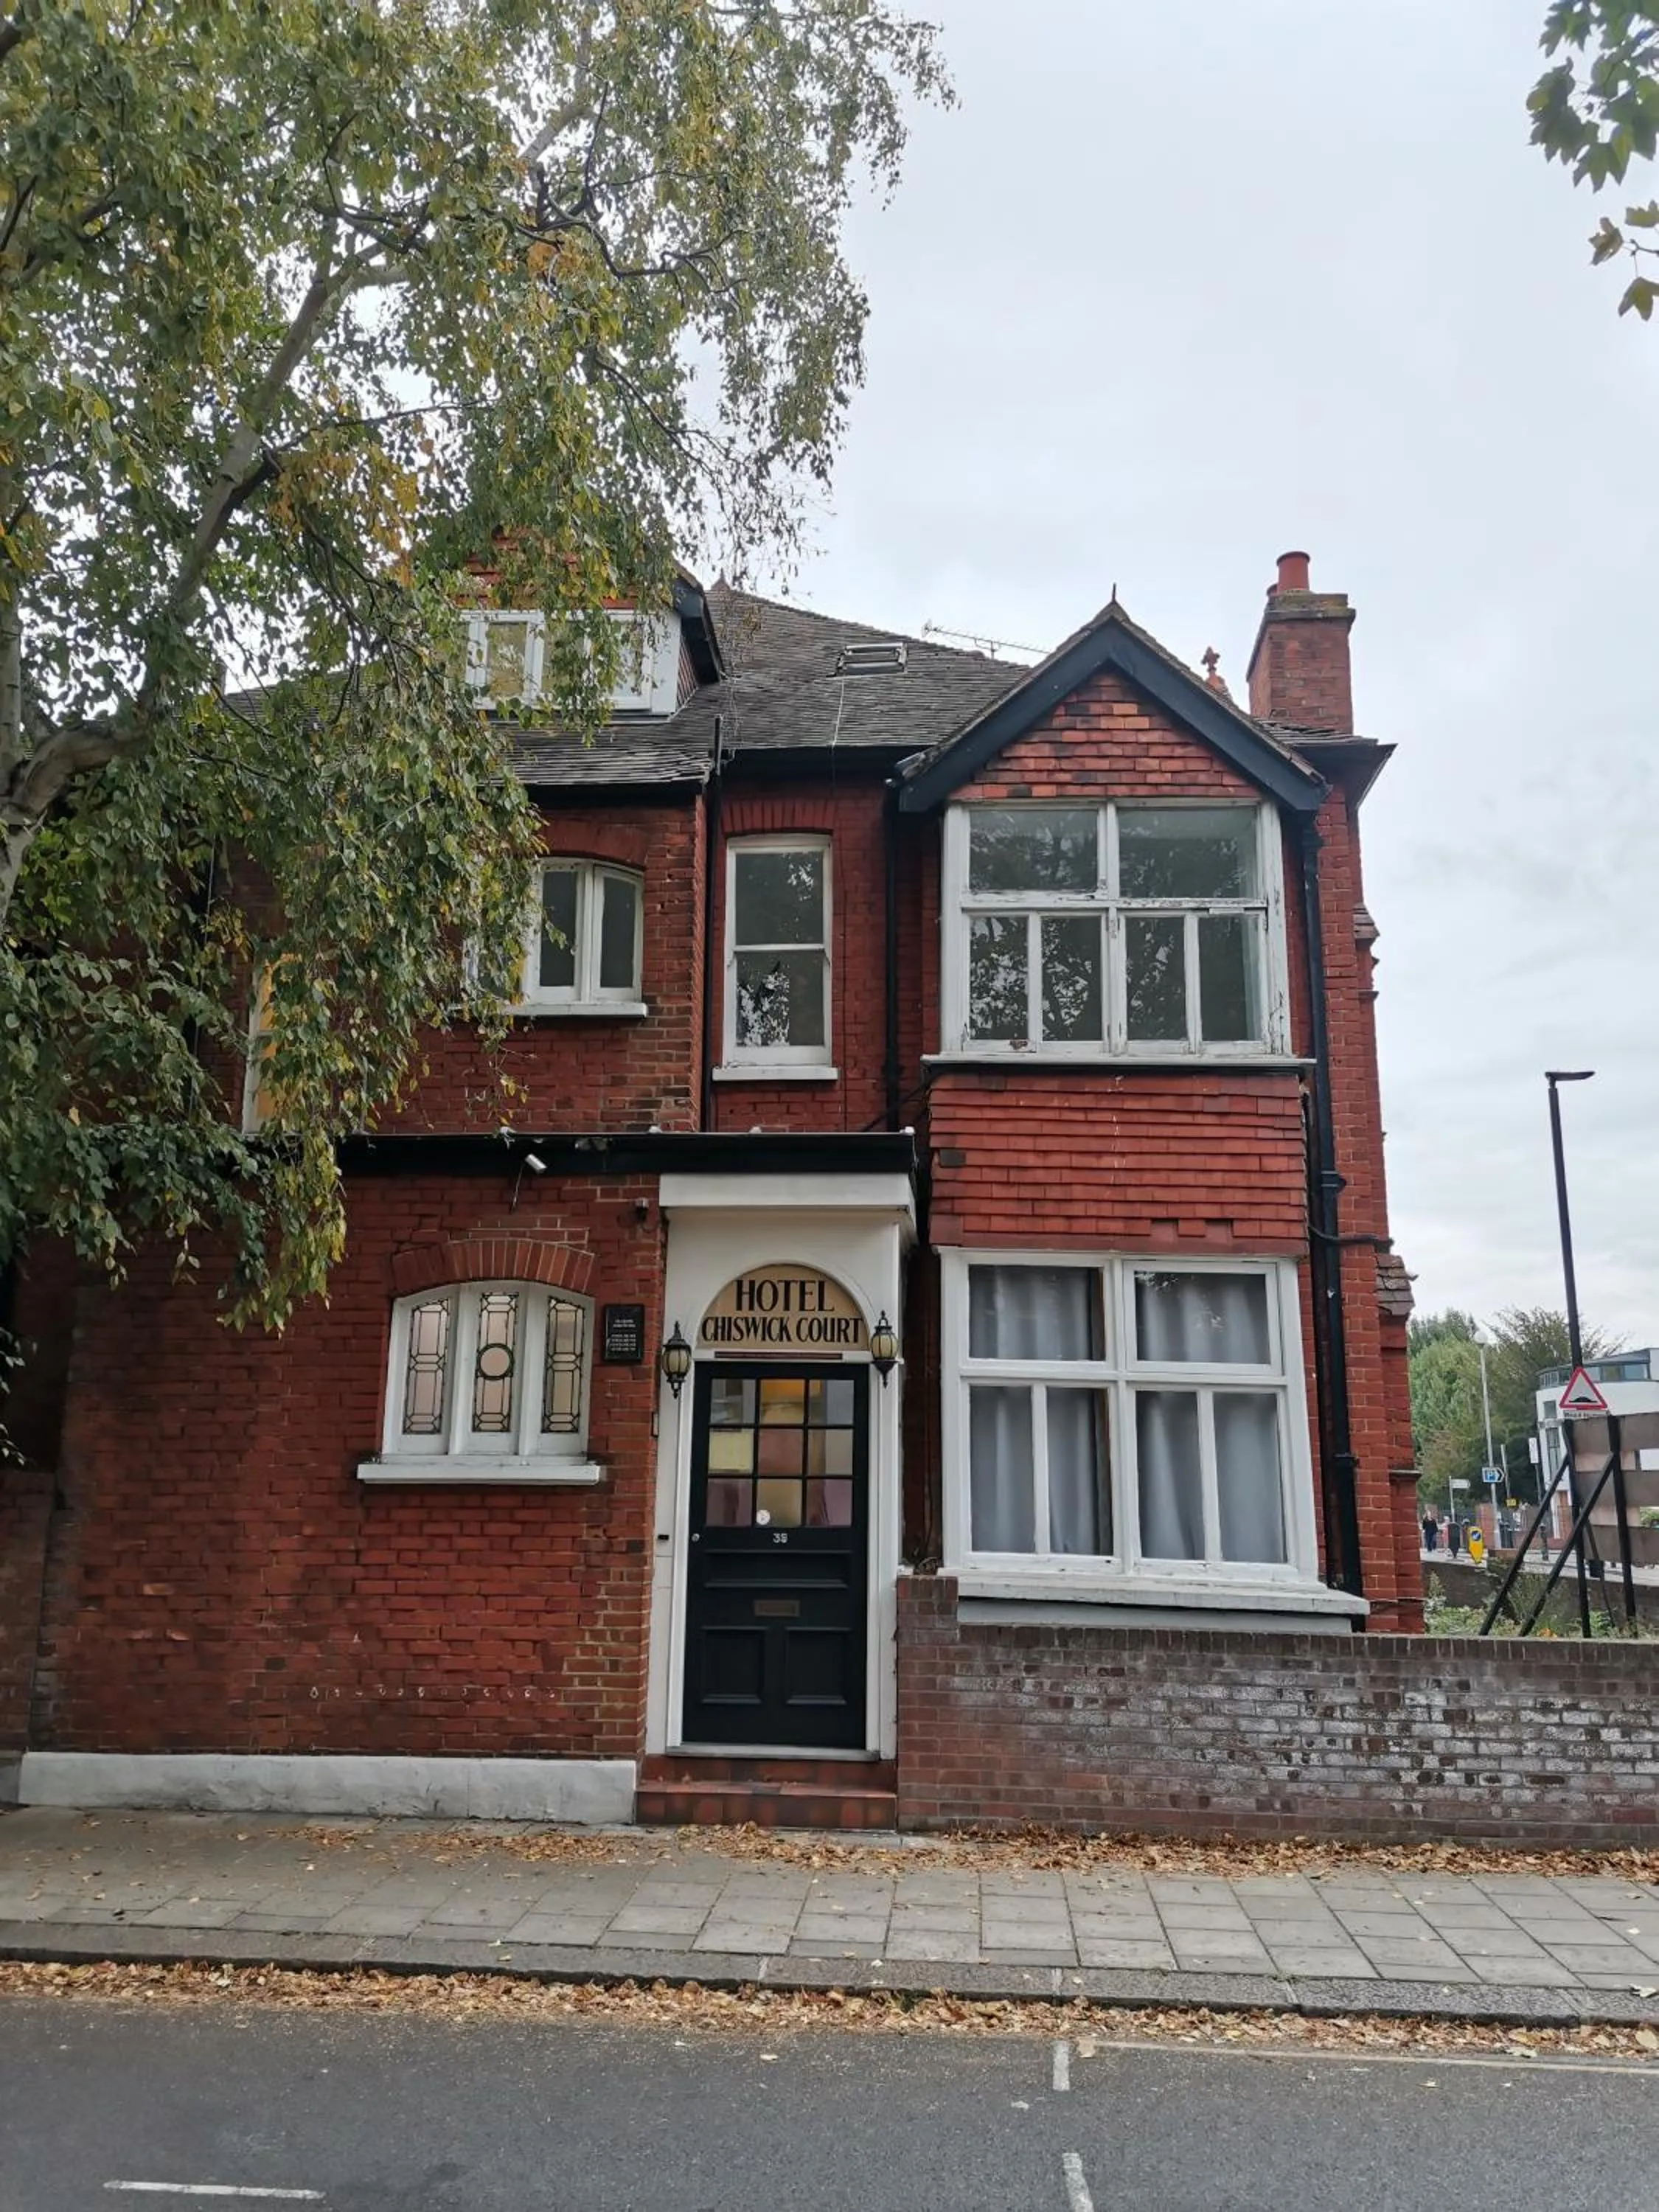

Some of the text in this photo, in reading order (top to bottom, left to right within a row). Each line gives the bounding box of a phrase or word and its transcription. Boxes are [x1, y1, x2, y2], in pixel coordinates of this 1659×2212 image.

[735, 1279, 835, 1312] HOTEL
[701, 1316, 863, 1343] CHISWICK COURT
